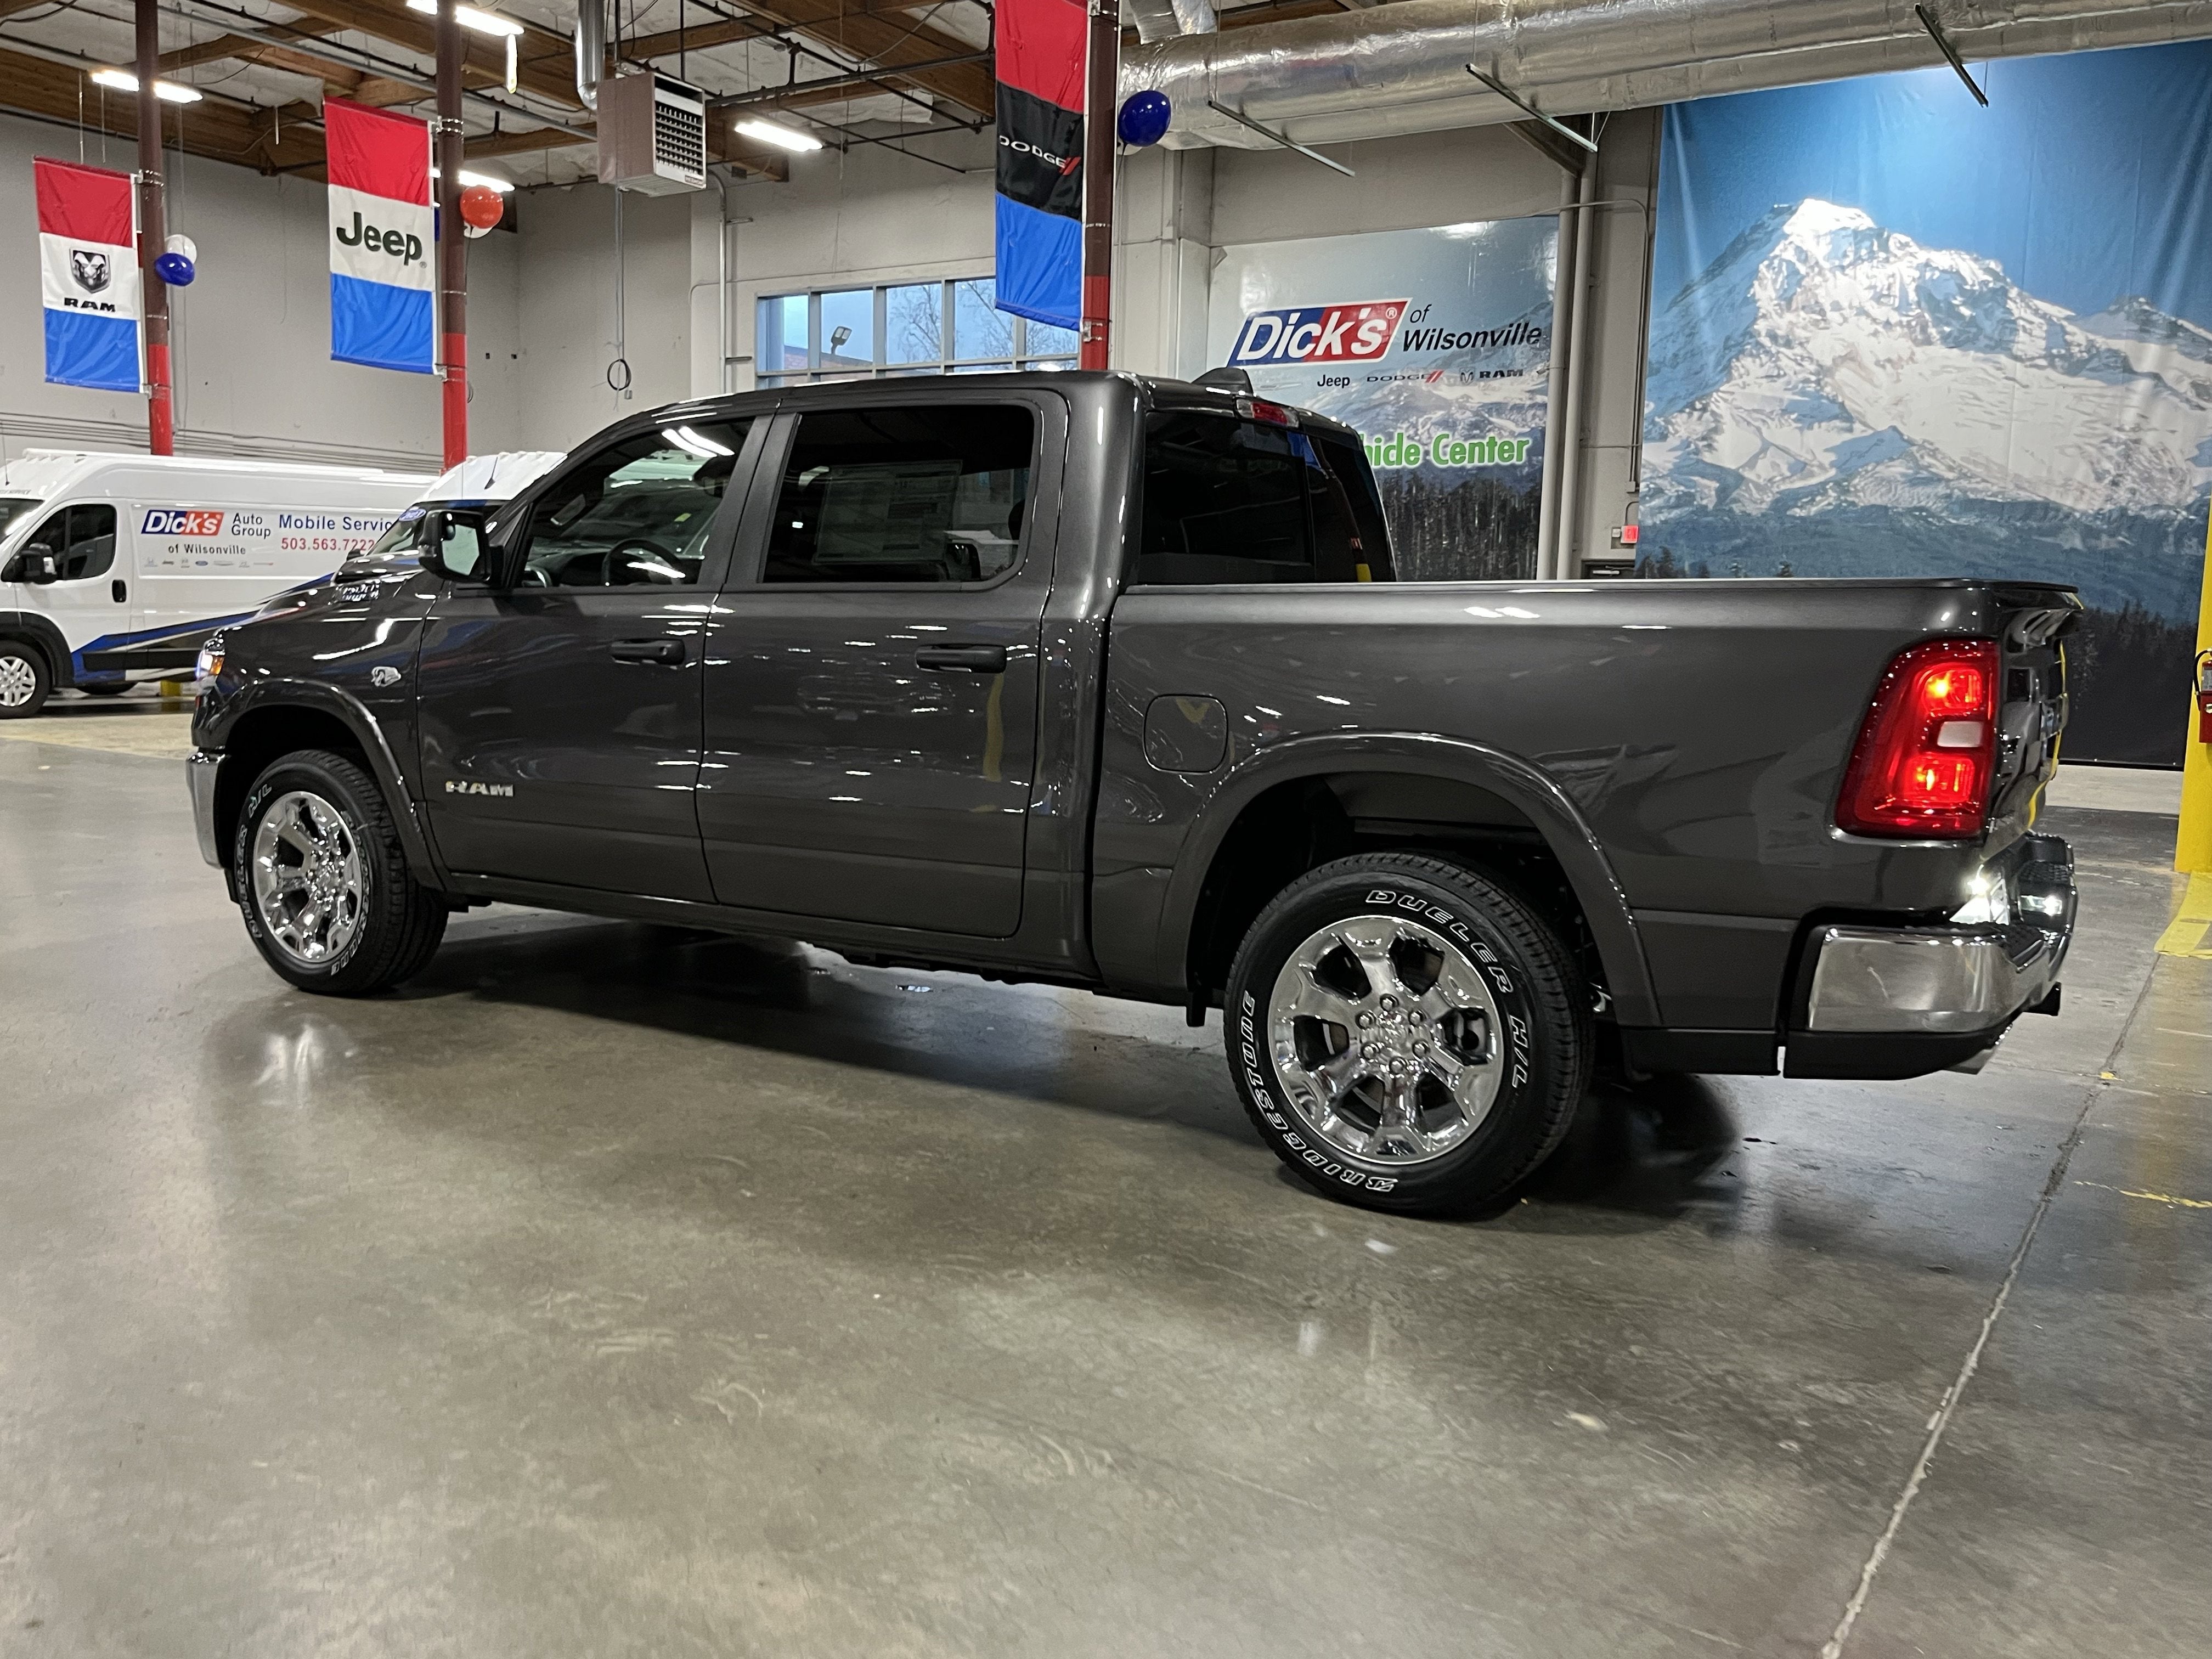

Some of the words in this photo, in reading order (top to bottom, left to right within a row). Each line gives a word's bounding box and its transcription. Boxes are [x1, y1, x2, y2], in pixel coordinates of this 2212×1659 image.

[999, 135, 1066, 169] DODGE
[336, 211, 422, 266] Jeep
[64, 297, 116, 313] RAM
[1236, 308, 1387, 361] Dick's
[1409, 305, 1432, 324] of
[1402, 323, 1542, 353] Wilsonville
[1317, 374, 1350, 388] Jeep
[1479, 369, 1523, 379] RAM
[1432, 433, 1530, 465] Center
[145, 511, 217, 534] Dick's
[233, 512, 263, 525] Auto
[279, 514, 335, 529] Mobile
[342, 516, 393, 531] Servic
[231, 524, 271, 539] Group
[168, 544, 179, 554] of
[184, 544, 246, 554] Wilsonville
[281, 537, 375, 551] 503.563.7222
[445, 781, 514, 797] RAM
[1365, 890, 1513, 994] DUELER
[1509, 1014, 1530, 1088] H/L
[1239, 990, 1398, 1192] BRIDGESTONE
